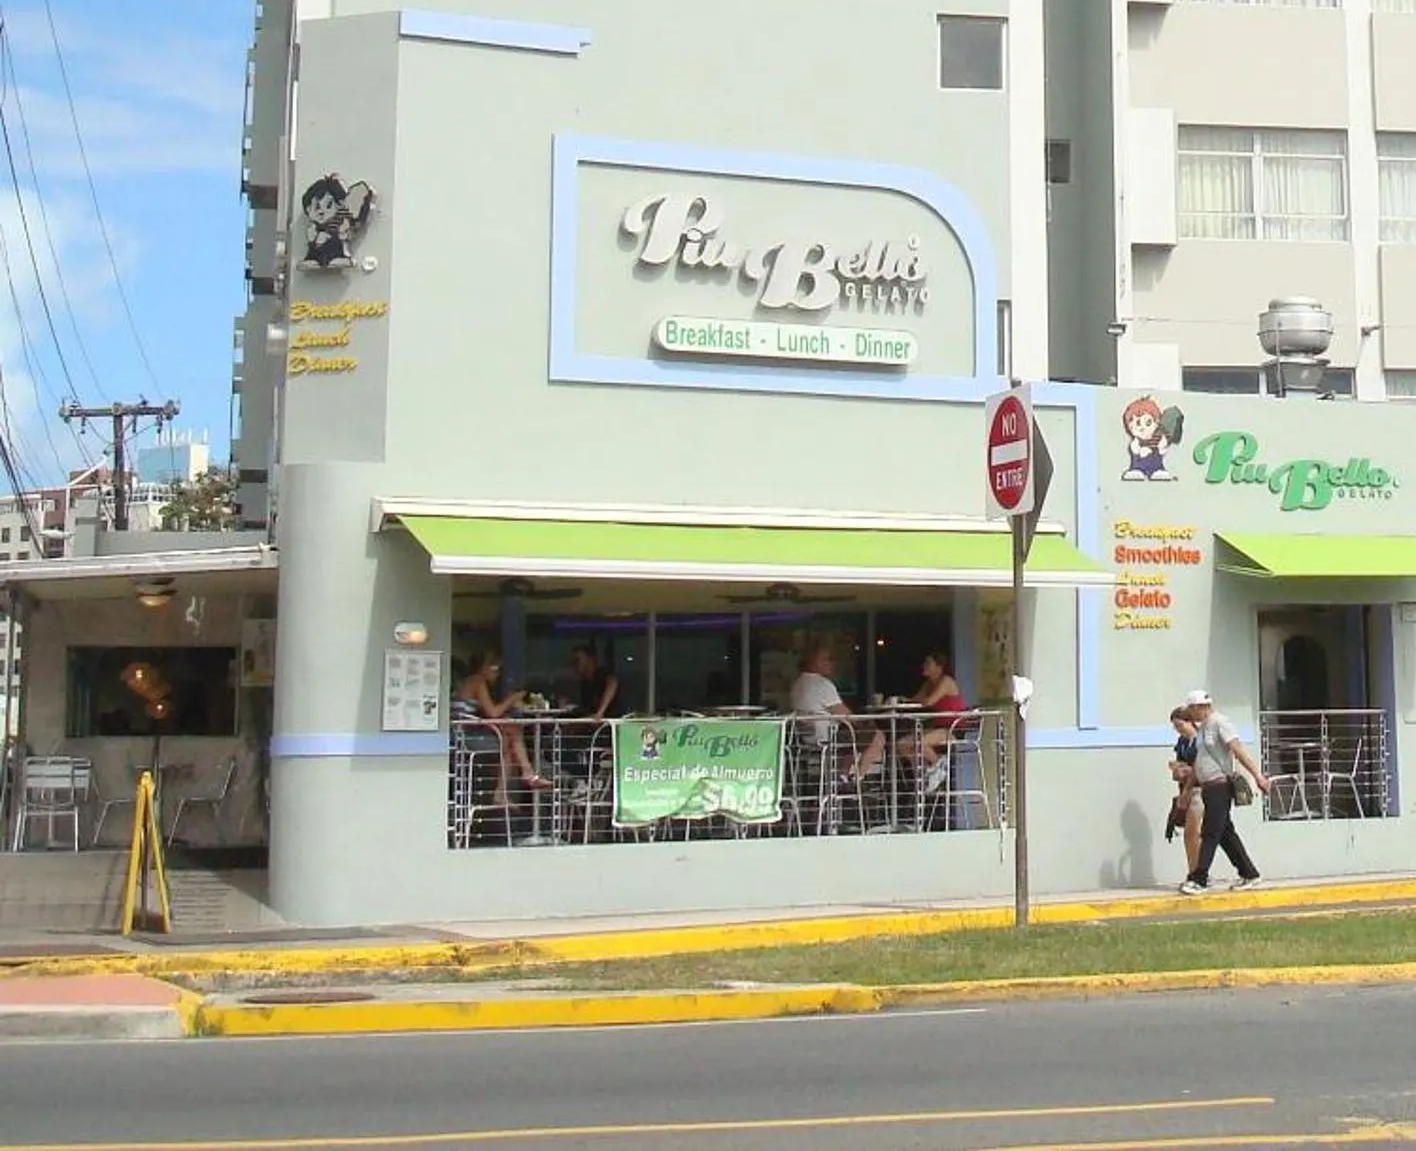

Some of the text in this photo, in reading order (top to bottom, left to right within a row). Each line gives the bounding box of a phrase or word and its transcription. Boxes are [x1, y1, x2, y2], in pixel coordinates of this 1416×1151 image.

[845, 282, 930, 303] GELATO
[665, 320, 911, 359] Breakfast Lunch Dinner
[1001, 412, 1017, 437] NO
[1114, 545, 1200, 565] Smoothies
[1114, 588, 1171, 608] Gelato
[624, 764, 687, 784] Especial
